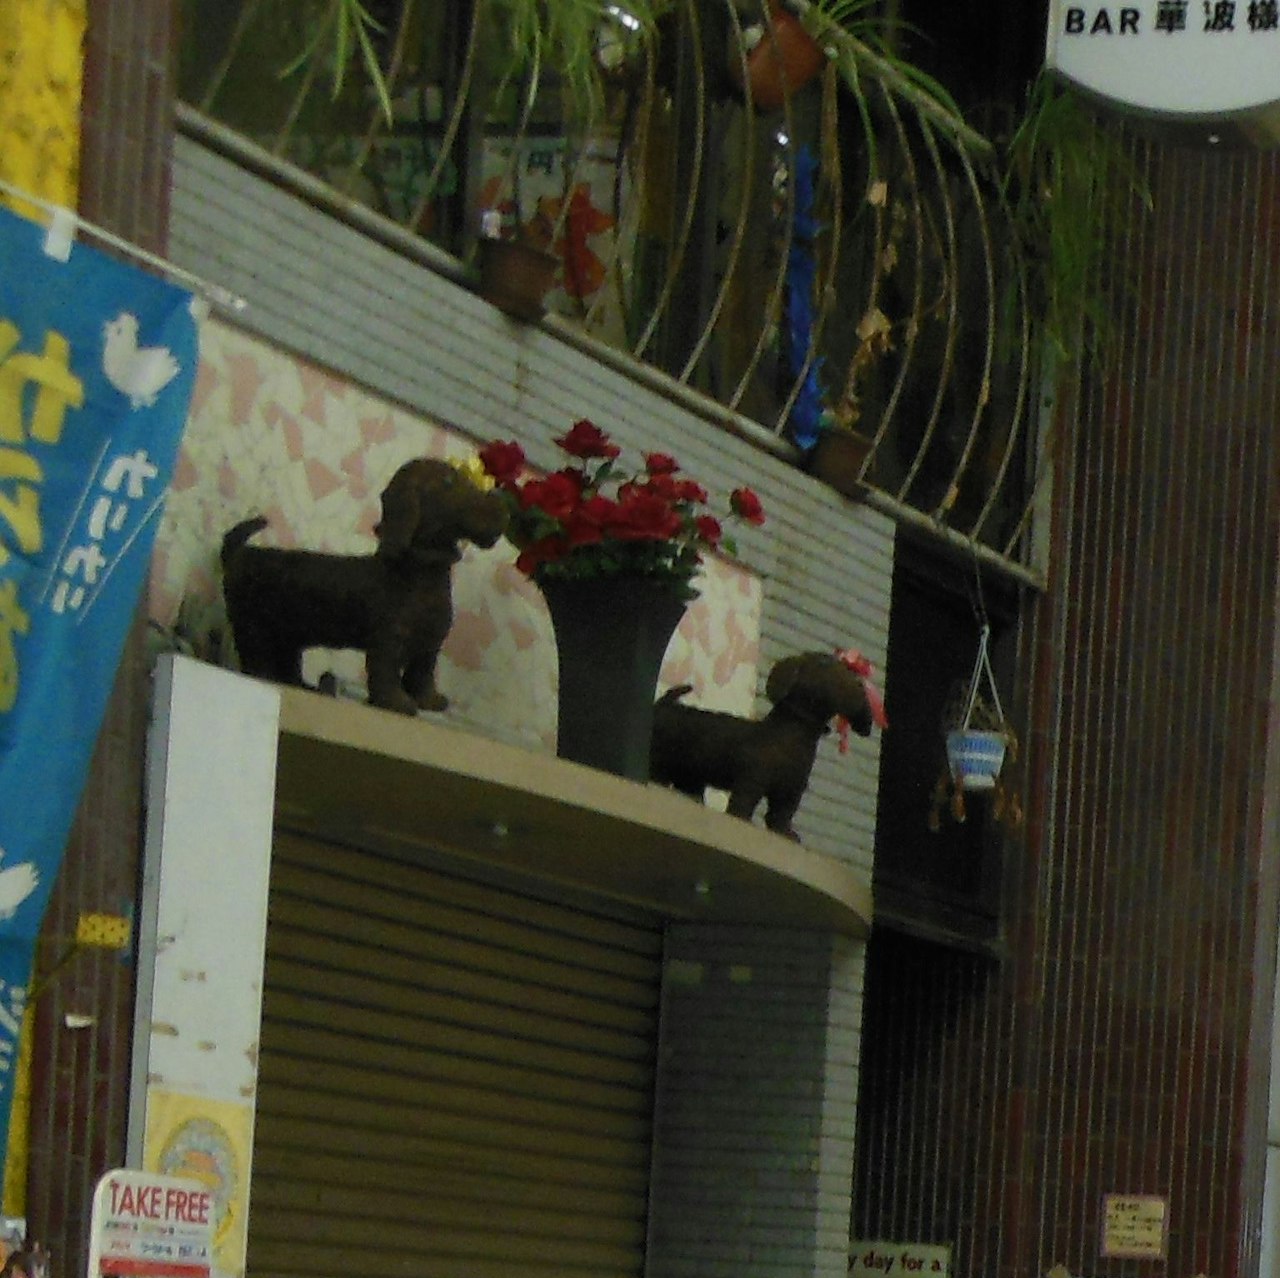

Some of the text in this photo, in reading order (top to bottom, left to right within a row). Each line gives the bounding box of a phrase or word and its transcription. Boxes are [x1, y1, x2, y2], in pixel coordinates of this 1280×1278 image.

[1064, 7, 1142, 36] BAR
[110, 1180, 210, 1225] TAKE FREE
